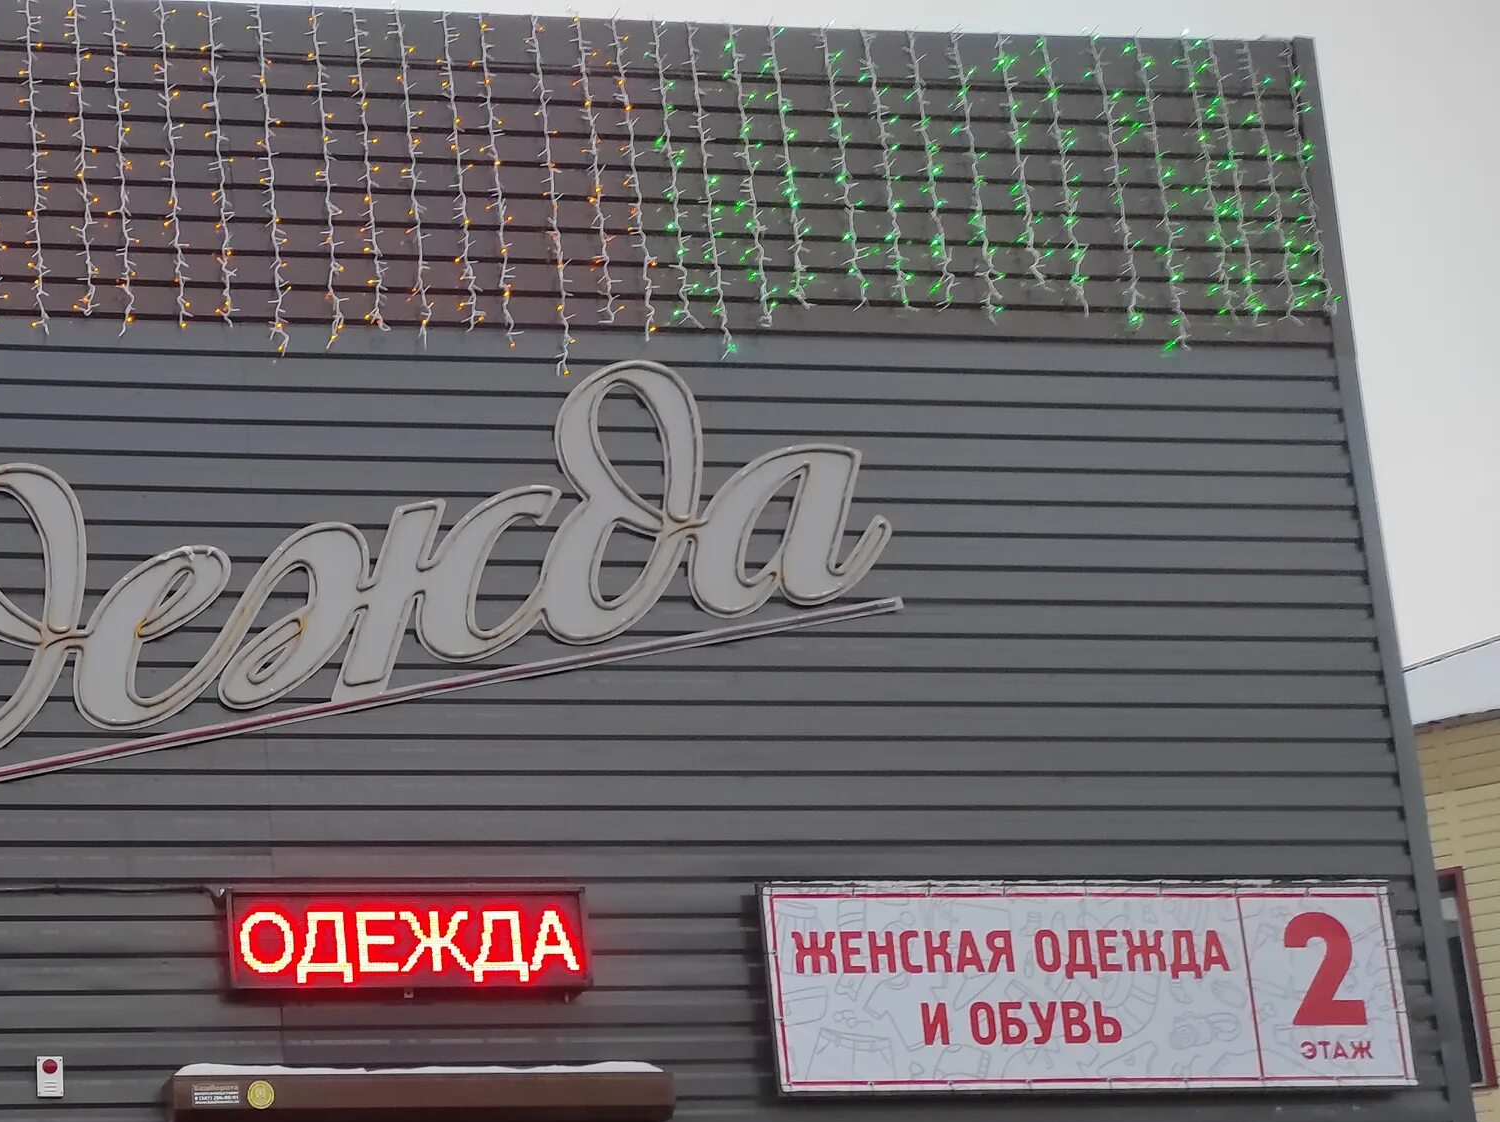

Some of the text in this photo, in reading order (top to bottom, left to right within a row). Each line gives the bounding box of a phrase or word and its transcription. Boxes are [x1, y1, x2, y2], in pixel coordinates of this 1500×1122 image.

[239, 909, 580, 983] ОДЕЖДА
[792, 929, 1230, 980] ЖЕНСКАЯ ОДЕЖДА
[1284, 911, 1368, 1026] 2
[922, 1001, 1122, 1045] И ОБУВЬ
[1299, 1040, 1374, 1060] ЭТАЖ
